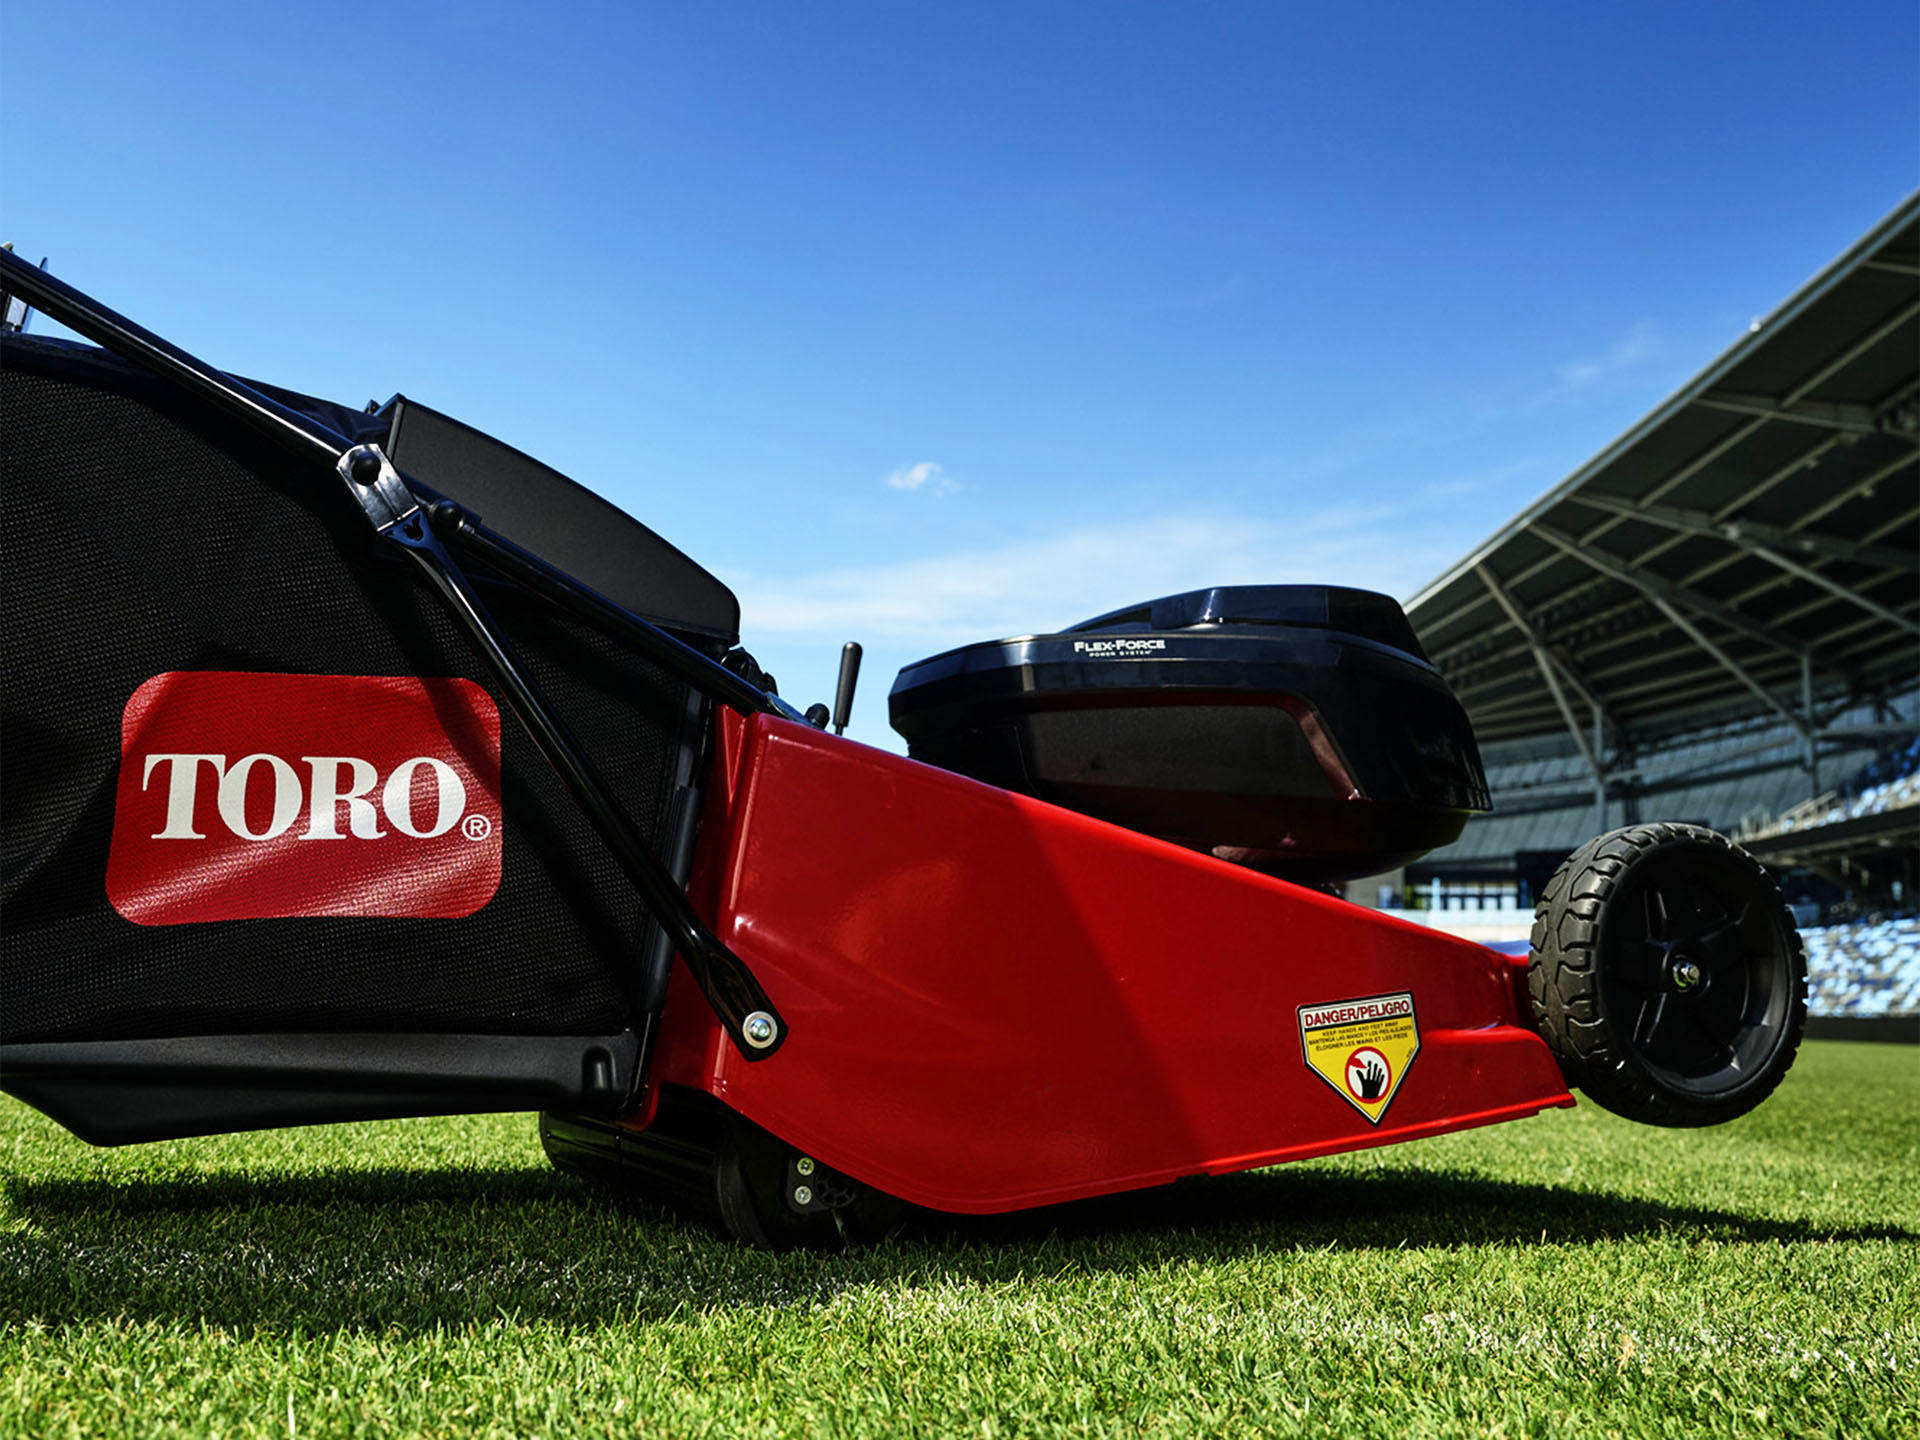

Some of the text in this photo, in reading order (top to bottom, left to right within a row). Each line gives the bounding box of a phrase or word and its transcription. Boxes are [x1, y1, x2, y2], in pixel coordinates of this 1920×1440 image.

[1074, 639, 1166, 653] FLEX-FORCE
[1304, 1000, 1410, 1027] DANGER/PELIGRO
[1357, 1037, 1373, 1045] MAINS
